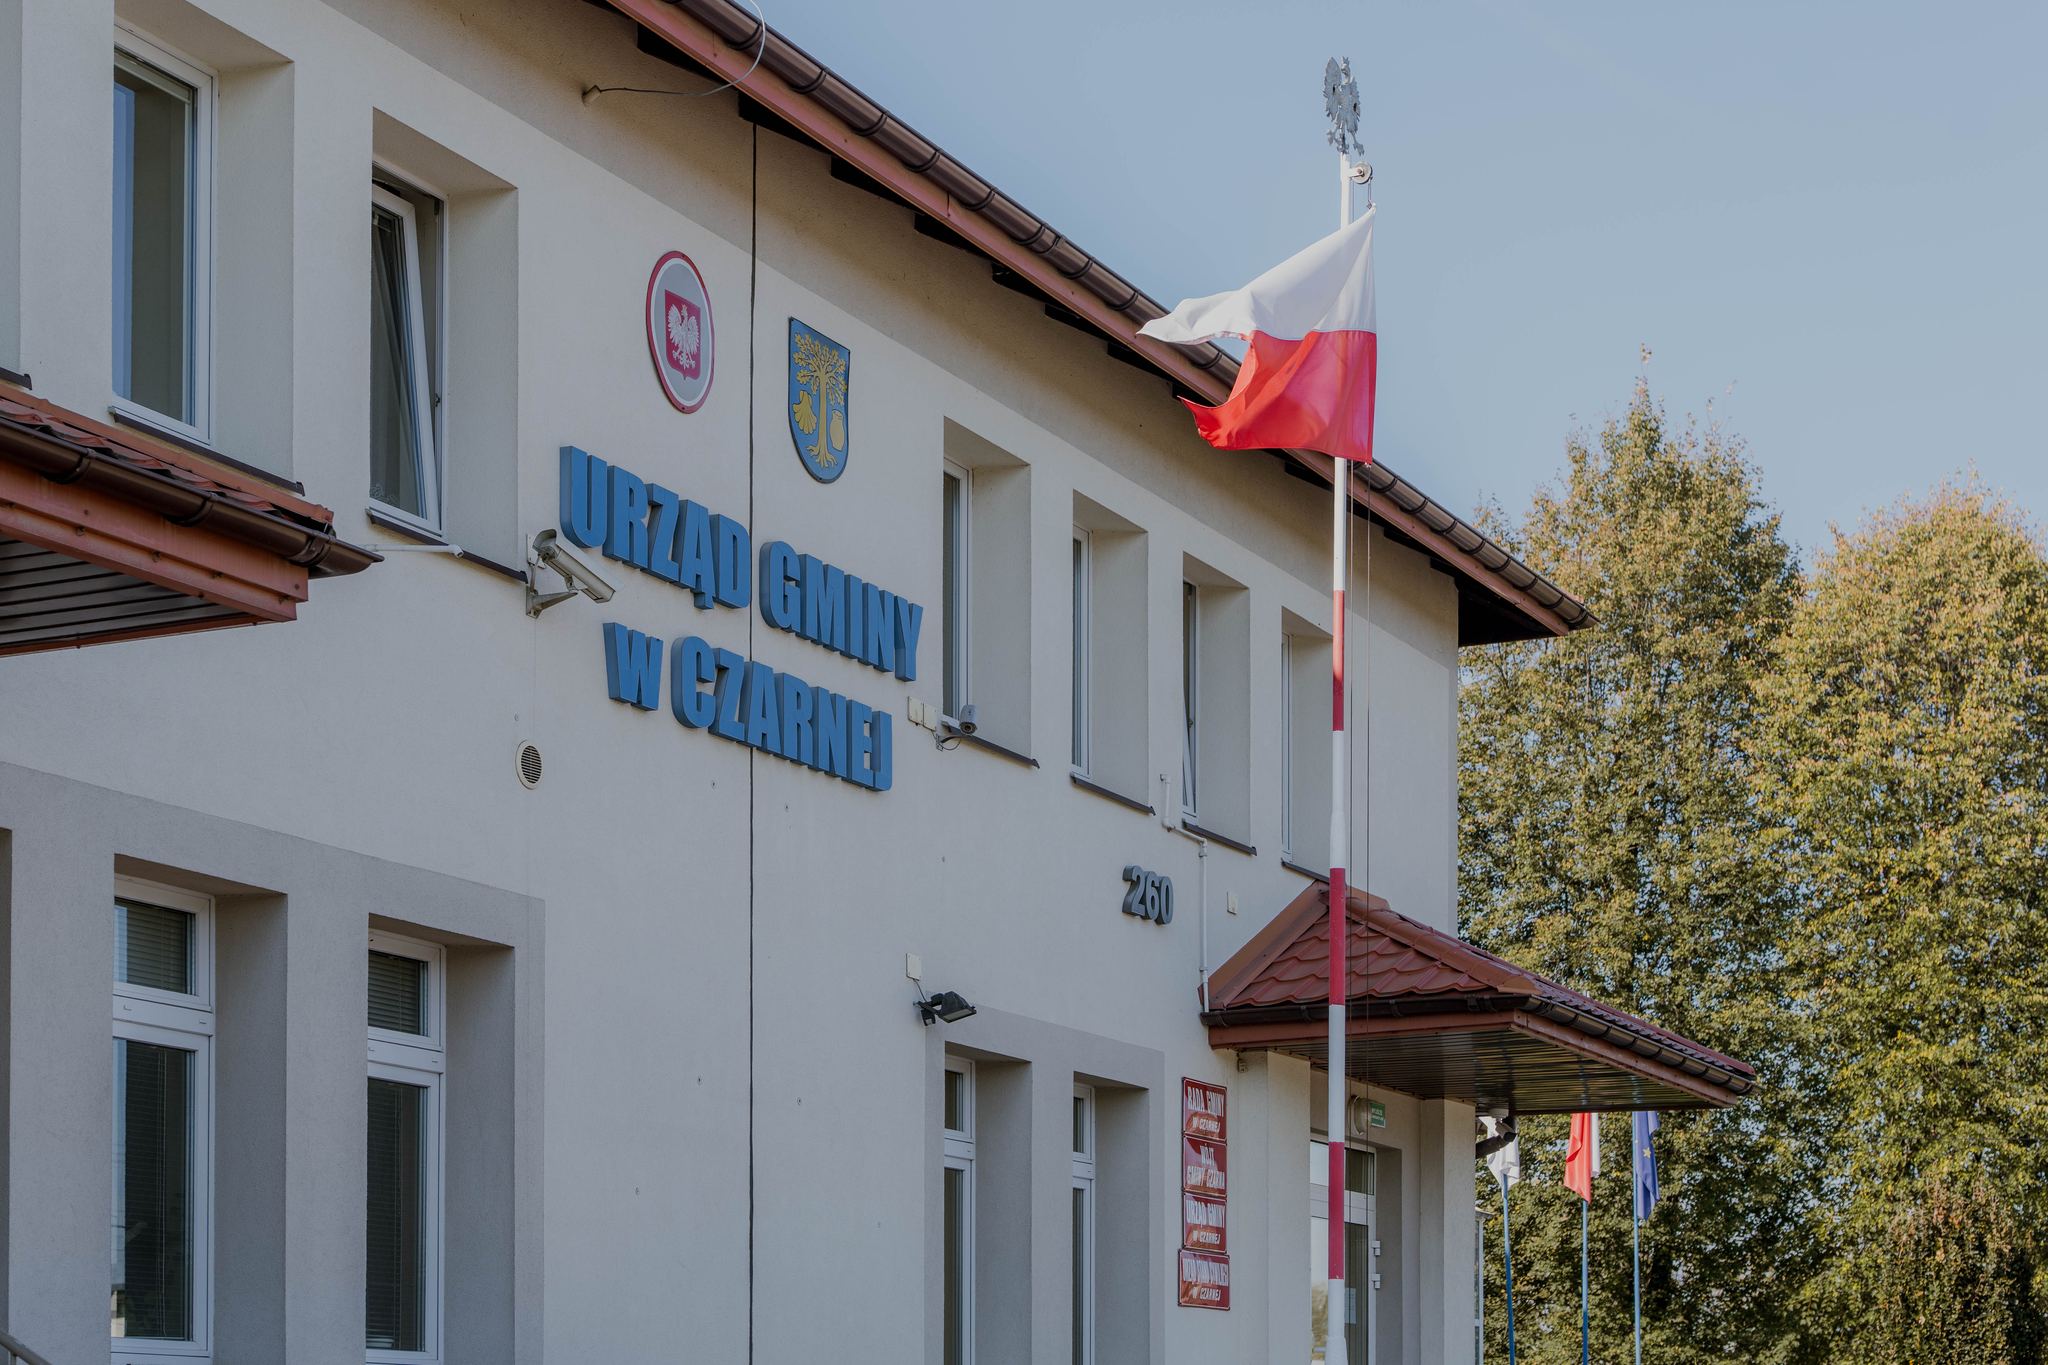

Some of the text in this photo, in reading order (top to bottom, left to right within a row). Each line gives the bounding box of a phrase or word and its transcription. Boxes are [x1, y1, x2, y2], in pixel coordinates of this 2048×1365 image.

[560, 446, 923, 681] URZĄD GMINY
[603, 622, 892, 791] W CZARNEJ
[1122, 865, 1173, 925] 260
